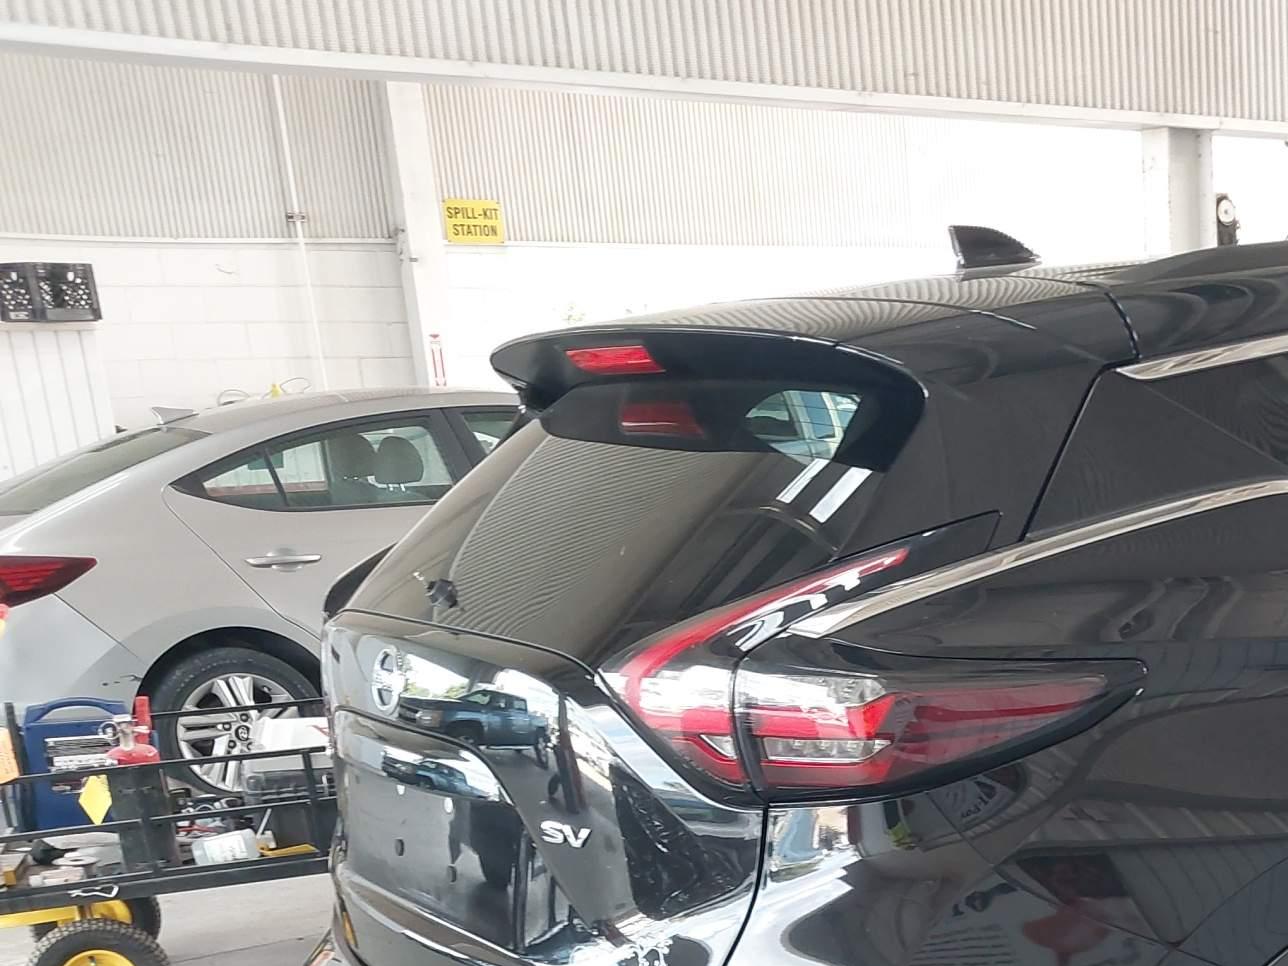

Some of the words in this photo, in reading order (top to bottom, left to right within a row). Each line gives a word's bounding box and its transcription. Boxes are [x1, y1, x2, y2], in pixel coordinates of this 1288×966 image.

[446, 206, 499, 220] SPILL-KIT
[452, 223, 498, 237] STATION
[540, 820, 592, 848] SV
